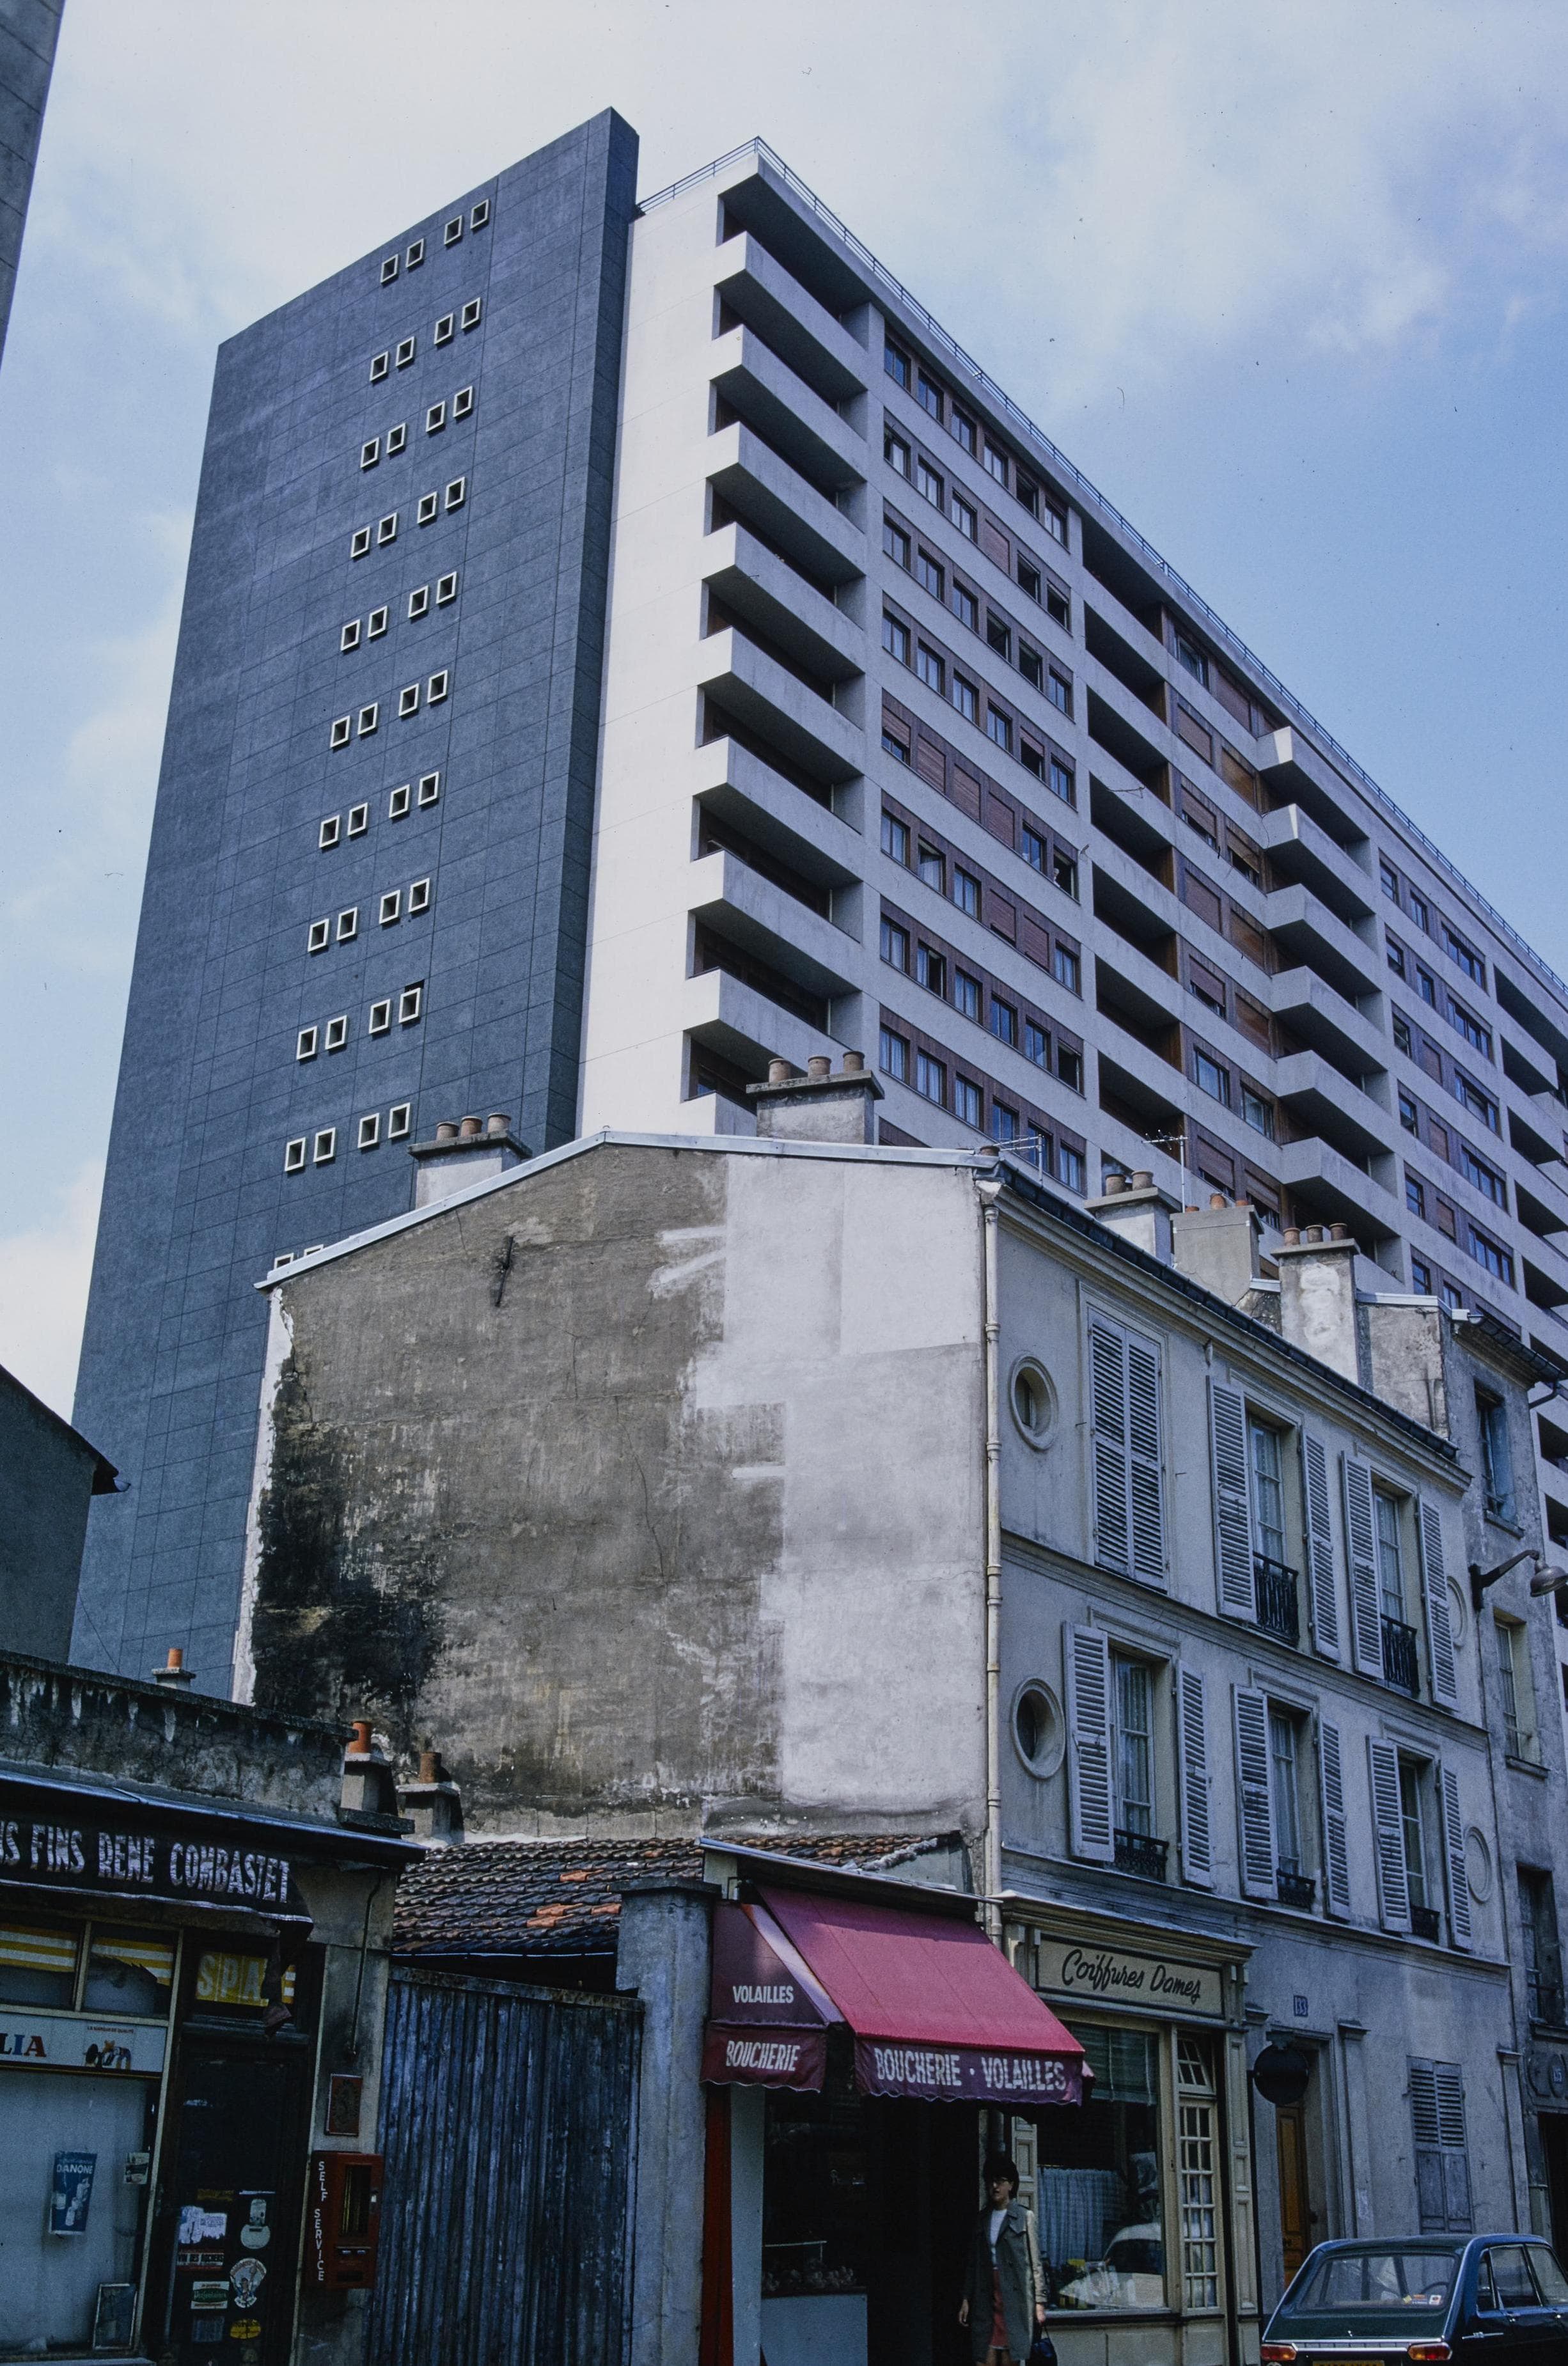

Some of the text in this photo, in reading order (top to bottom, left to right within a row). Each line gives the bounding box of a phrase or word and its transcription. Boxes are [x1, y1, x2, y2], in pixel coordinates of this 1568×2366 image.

[30, 1824, 85, 1874] FINS
[98, 1832, 155, 1884] RENE
[169, 1842, 290, 1903] COMBASTET
[732, 1985, 794, 2003] VOLAILLES
[1062, 1949, 1202, 2005] Coiffures Dames
[1294, 1996, 1307, 2015] 133
[726, 2041, 801, 2071] BOUCHERIE
[874, 2048, 1066, 2091] BOUCHERIE VOLAILLES
[56, 2163, 93, 2175] DANONE
[318, 2161, 328, 2202] SELF
[314, 2208, 325, 2282] SERVICE
